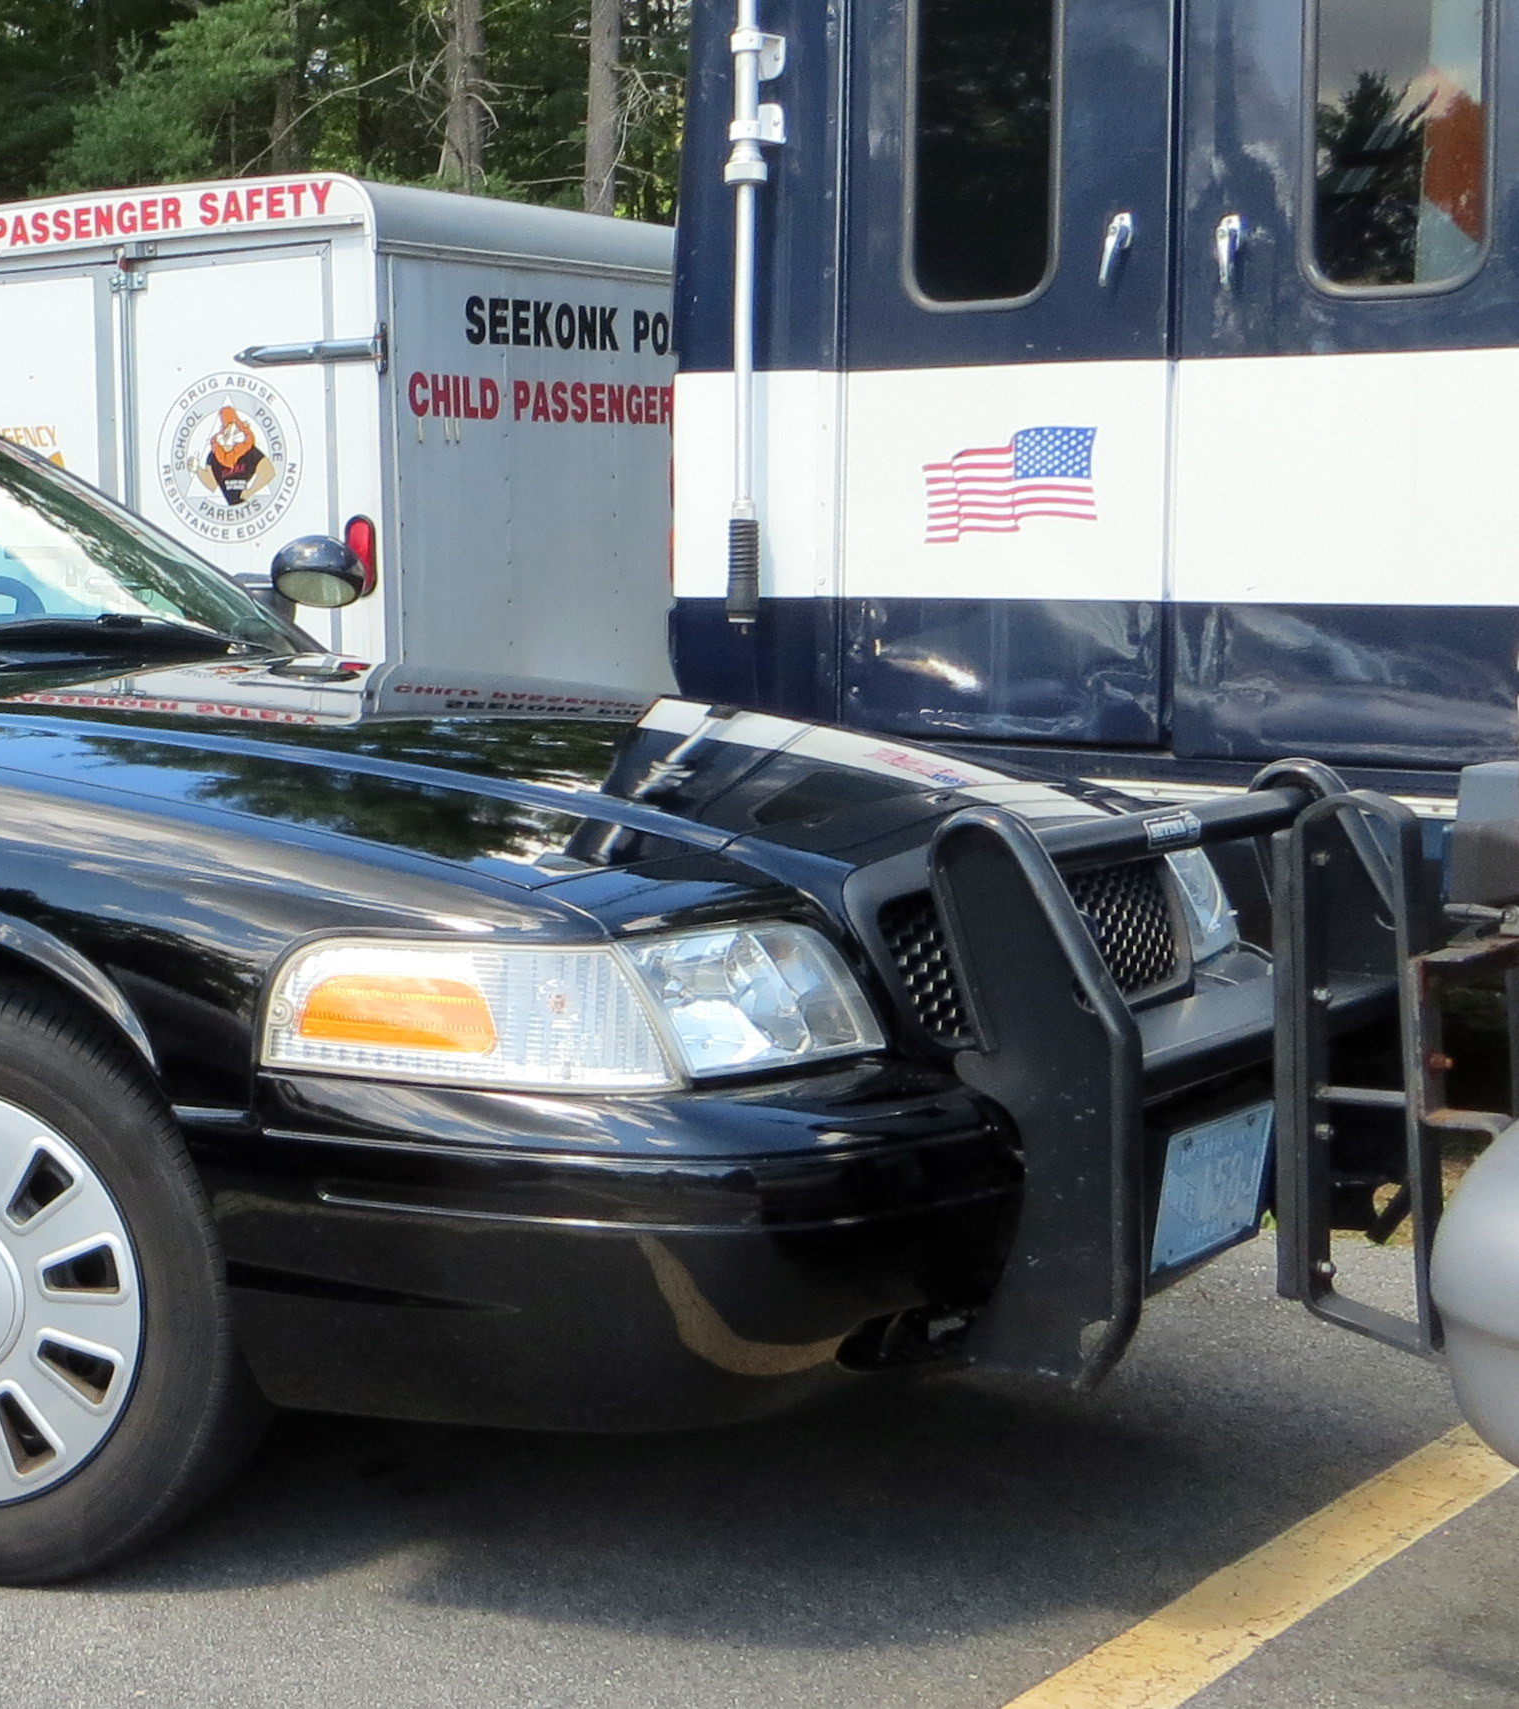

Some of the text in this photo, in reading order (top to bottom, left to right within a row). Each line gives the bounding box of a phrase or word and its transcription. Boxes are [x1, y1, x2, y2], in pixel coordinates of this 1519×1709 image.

[199, 181, 332, 226] SAFETY
[465, 296, 619, 351] SEEKONK
[179, 376, 277, 410] DRUG ABUSE
[408, 372, 673, 424] CHILD PASSENGER
[175, 410, 204, 471] SCHOOL
[255, 408, 283, 462] POLICE
[162, 463, 297, 539] RESISTANCE EDUCATION
[199, 499, 262, 521] PARENTS
